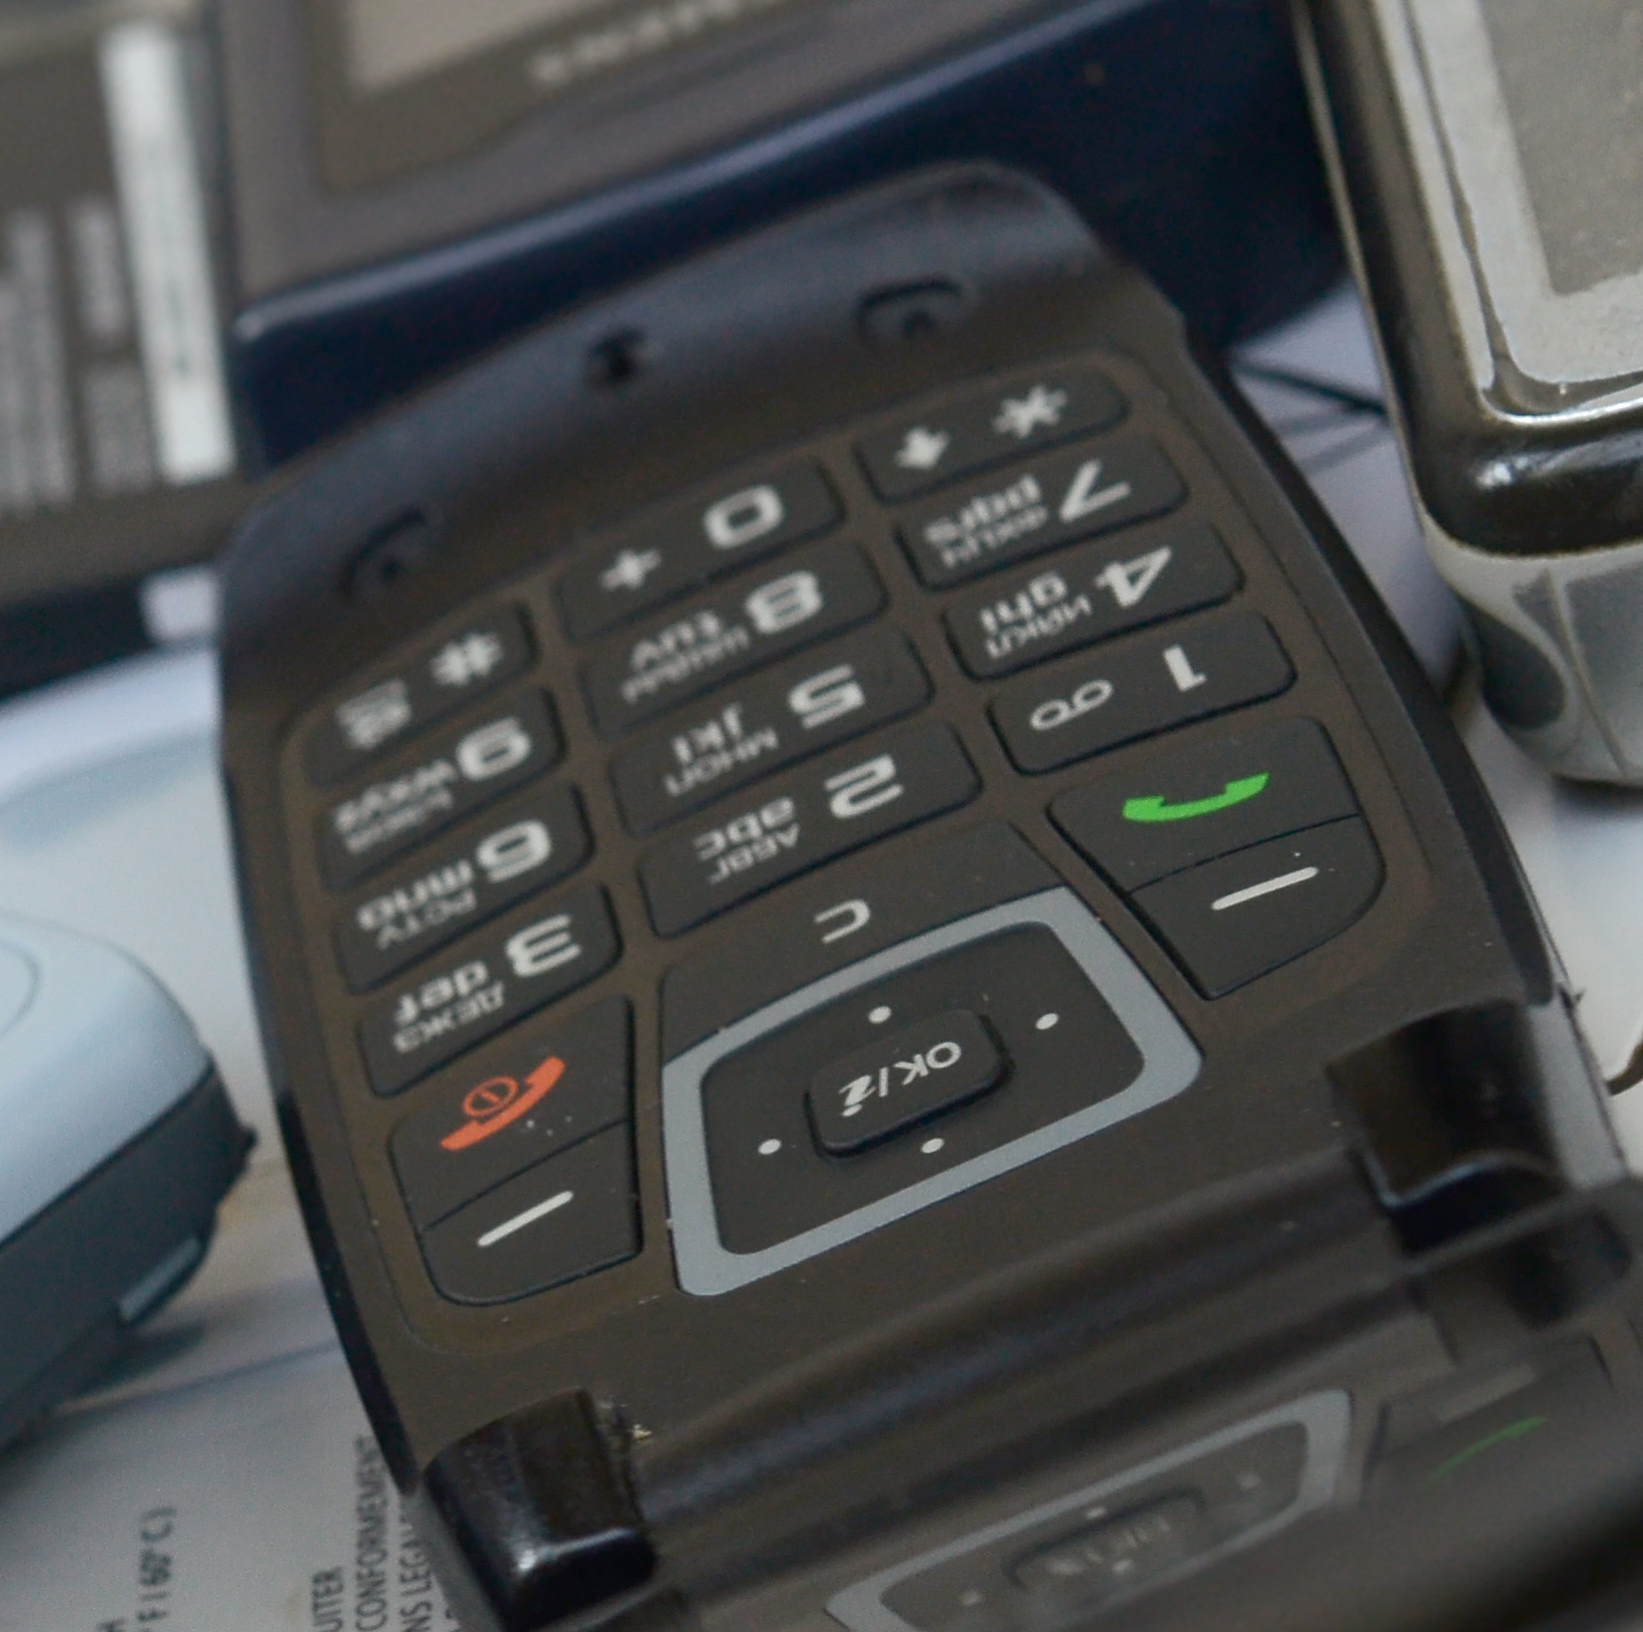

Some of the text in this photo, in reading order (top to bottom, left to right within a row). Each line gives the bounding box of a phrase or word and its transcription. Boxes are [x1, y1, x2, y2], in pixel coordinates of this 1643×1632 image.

[701, 482, 786, 554] 0
[1058, 459, 1131, 521] 7
[745, 570, 823, 635] 8
[980, 572, 1068, 634] ghi
[1094, 545, 1173, 607] 4
[788, 663, 865, 730] 5
[1163, 644, 1207, 692] 1
[457, 716, 532, 782] 9
[672, 702, 744, 764] jkl
[824, 754, 904, 820] 2
[477, 820, 551, 884] 6
[692, 797, 796, 861] abc
[357, 860, 474, 931] mno
[506, 915, 582, 978] 3
[396, 961, 488, 1026] def
